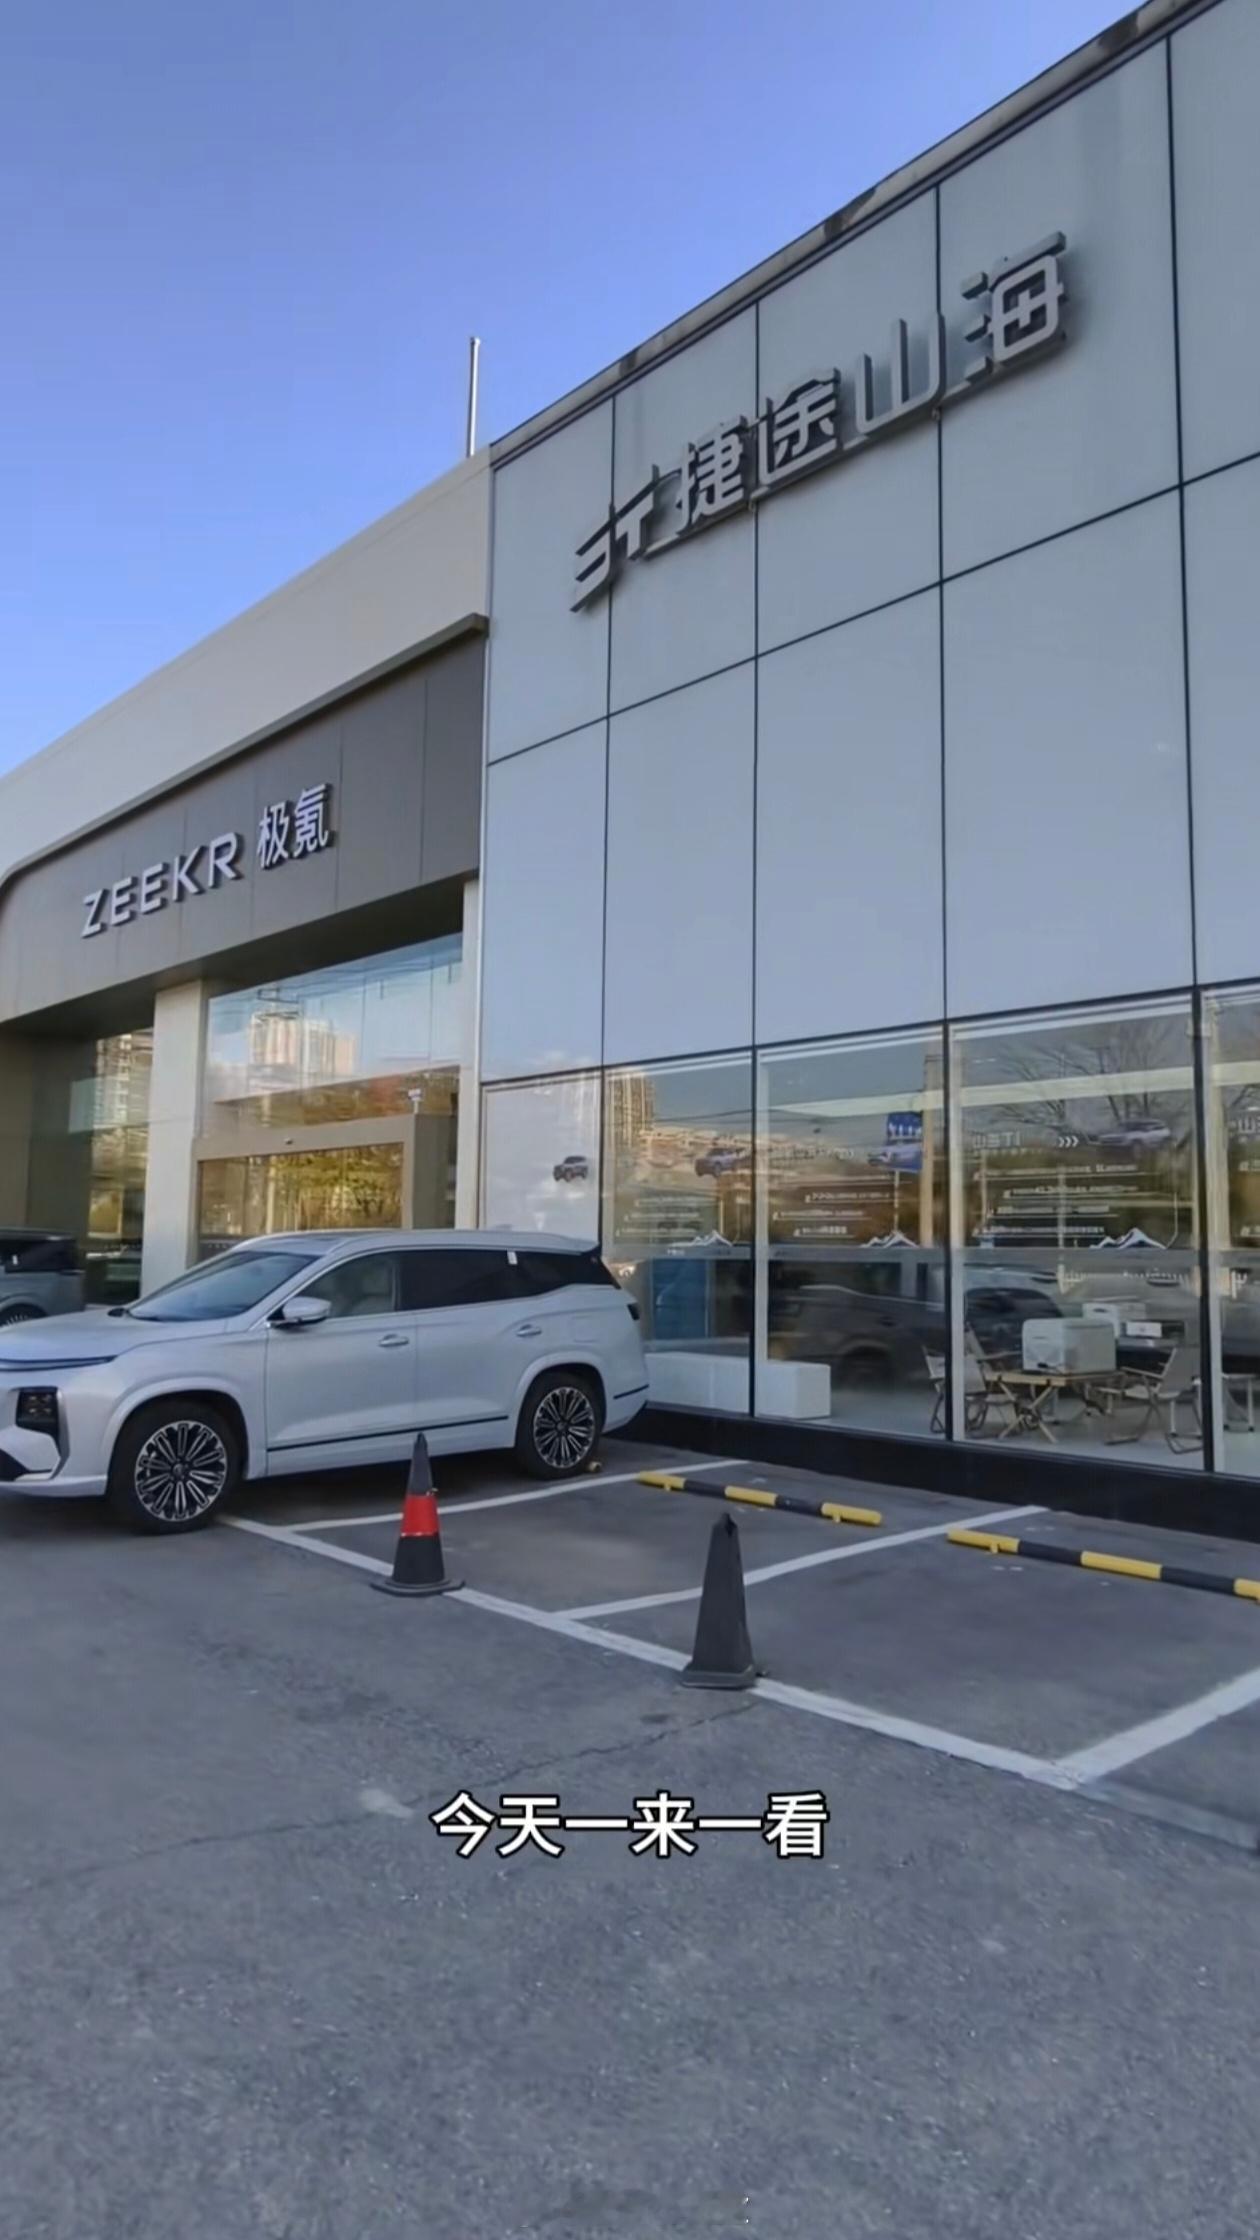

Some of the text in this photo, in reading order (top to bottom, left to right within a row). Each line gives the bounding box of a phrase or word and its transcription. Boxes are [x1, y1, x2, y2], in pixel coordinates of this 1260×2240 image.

[676, 231, 1067, 535] 捷途山海
[81, 783, 332, 939] ZEEKR 极氪
